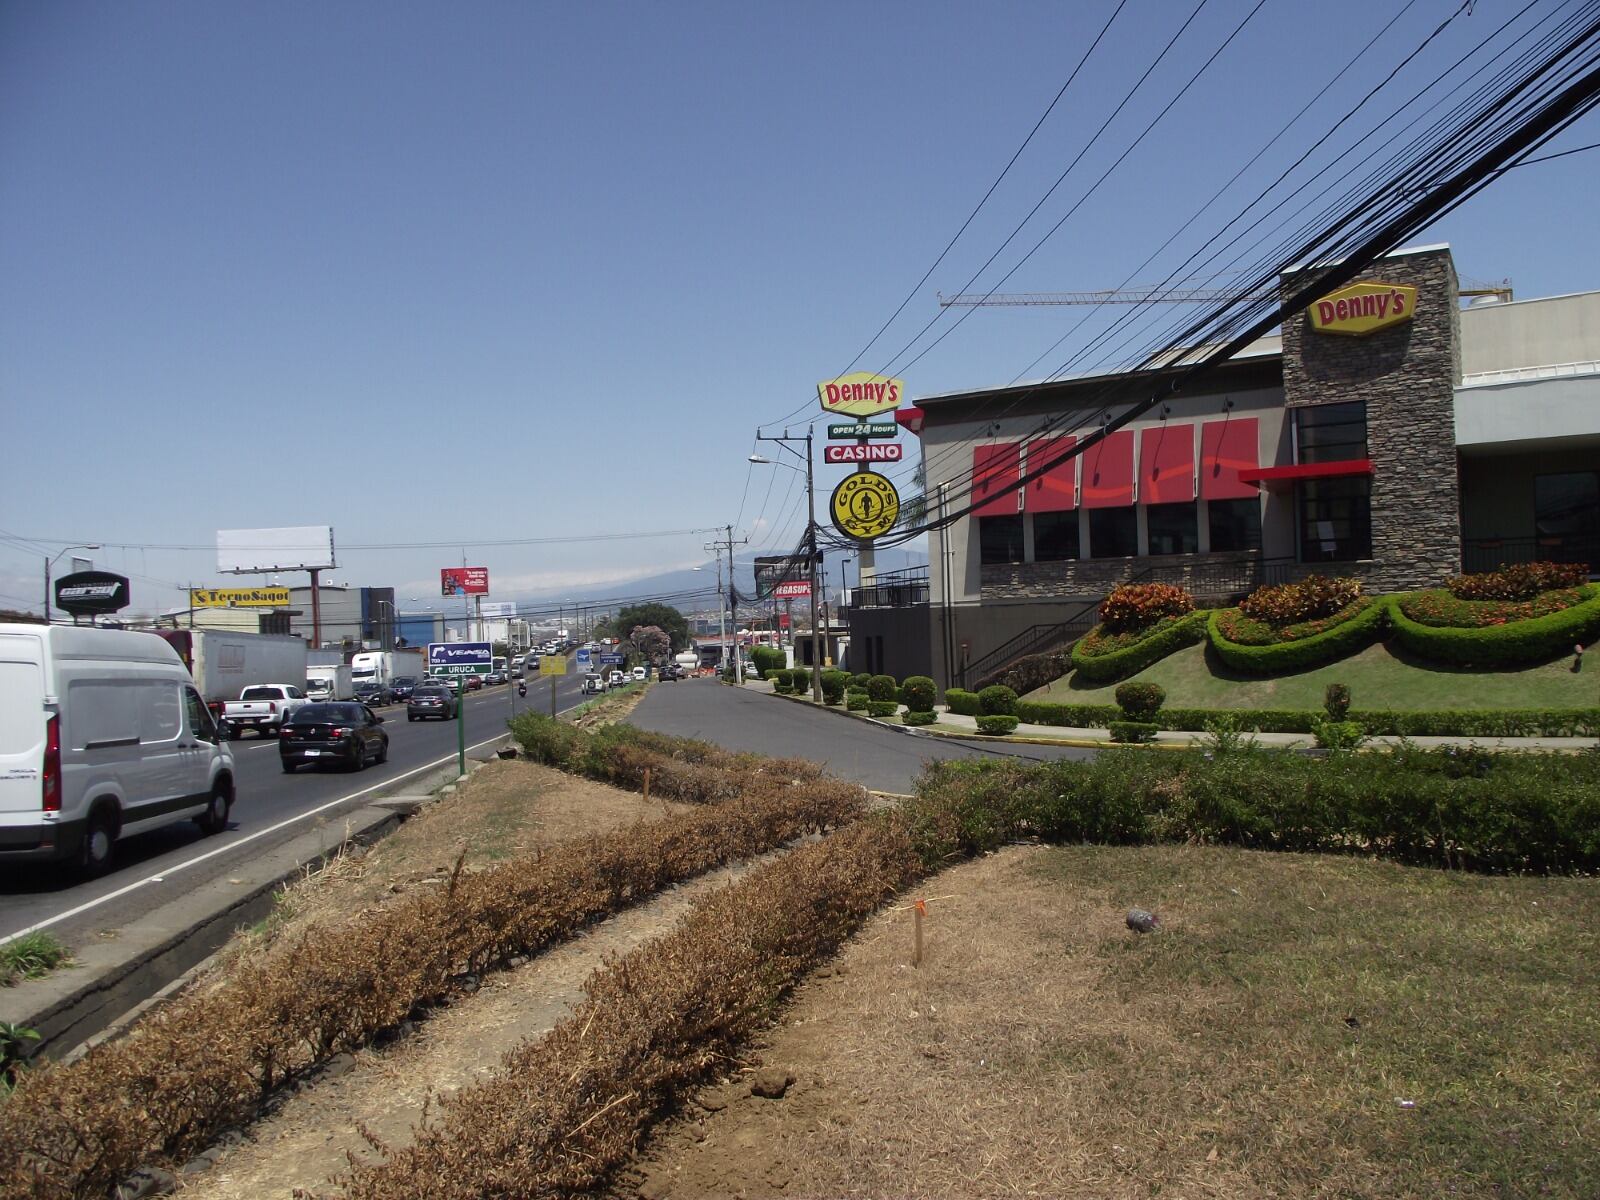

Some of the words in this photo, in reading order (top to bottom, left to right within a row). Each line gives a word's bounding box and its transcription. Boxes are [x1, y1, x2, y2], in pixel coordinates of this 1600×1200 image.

[1317, 289, 1405, 327] Denny's
[825, 380, 898, 405] Denny's
[854, 425, 871, 435] 24
[830, 446, 899, 460] CASINO
[839, 476, 894, 507] GOLD'S
[845, 515, 891, 534] GYM
[448, 665, 476, 674] URUCA
